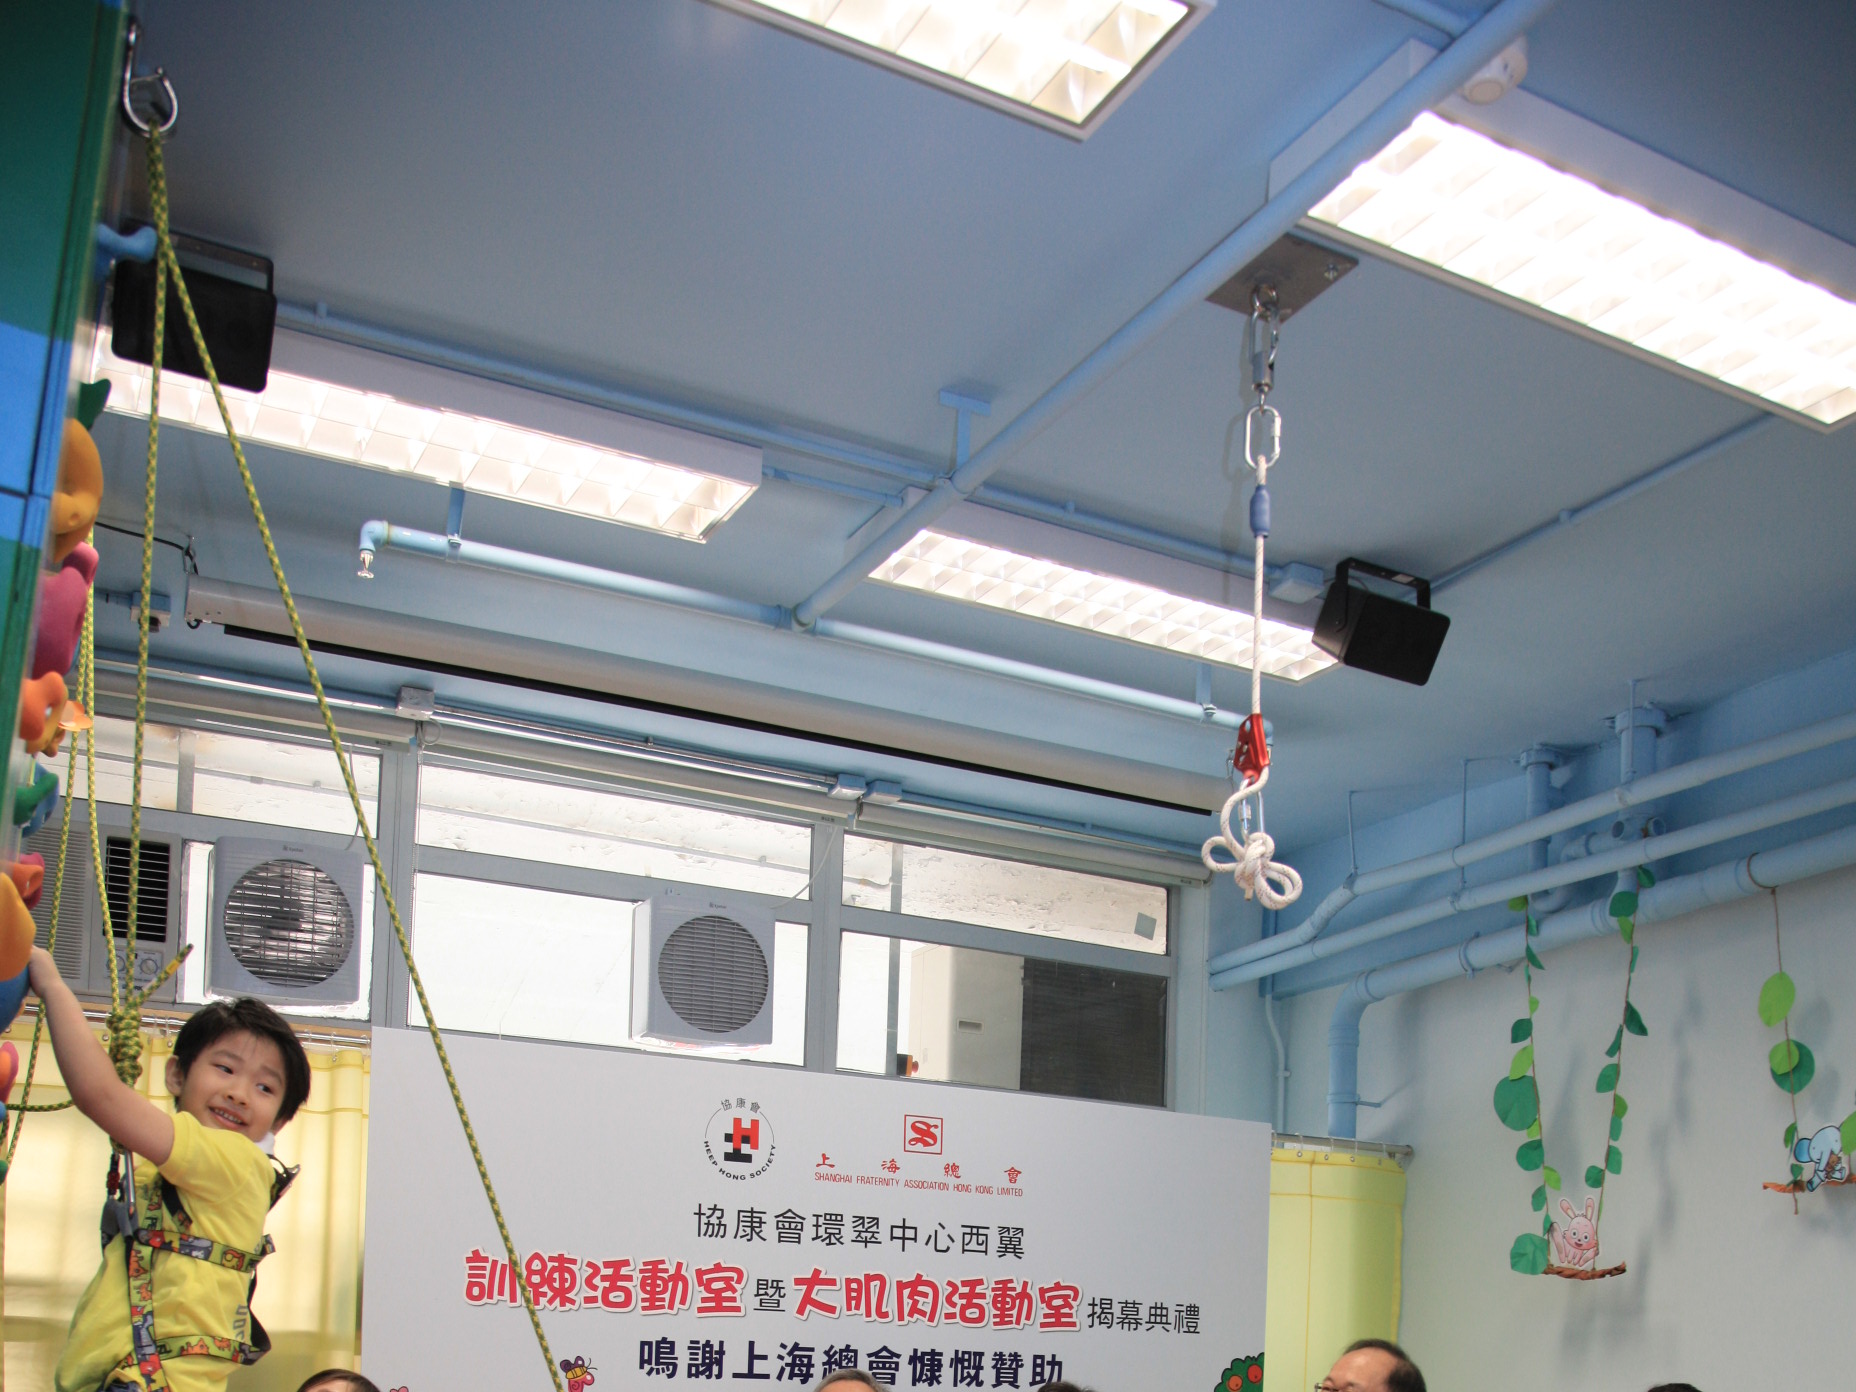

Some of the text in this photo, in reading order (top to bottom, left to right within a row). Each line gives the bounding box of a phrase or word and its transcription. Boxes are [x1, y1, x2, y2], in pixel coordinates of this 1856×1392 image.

[703, 1140, 776, 1181] HEEP HONG SOCIETY
[816, 1152, 1022, 1184] 上海總會
[814, 1171, 1023, 1197] SHANGHAI FRATERNITY ASSOCIATION HONG KONG LIMITED
[693, 1203, 1025, 1260] 協康會環翠中心西翼
